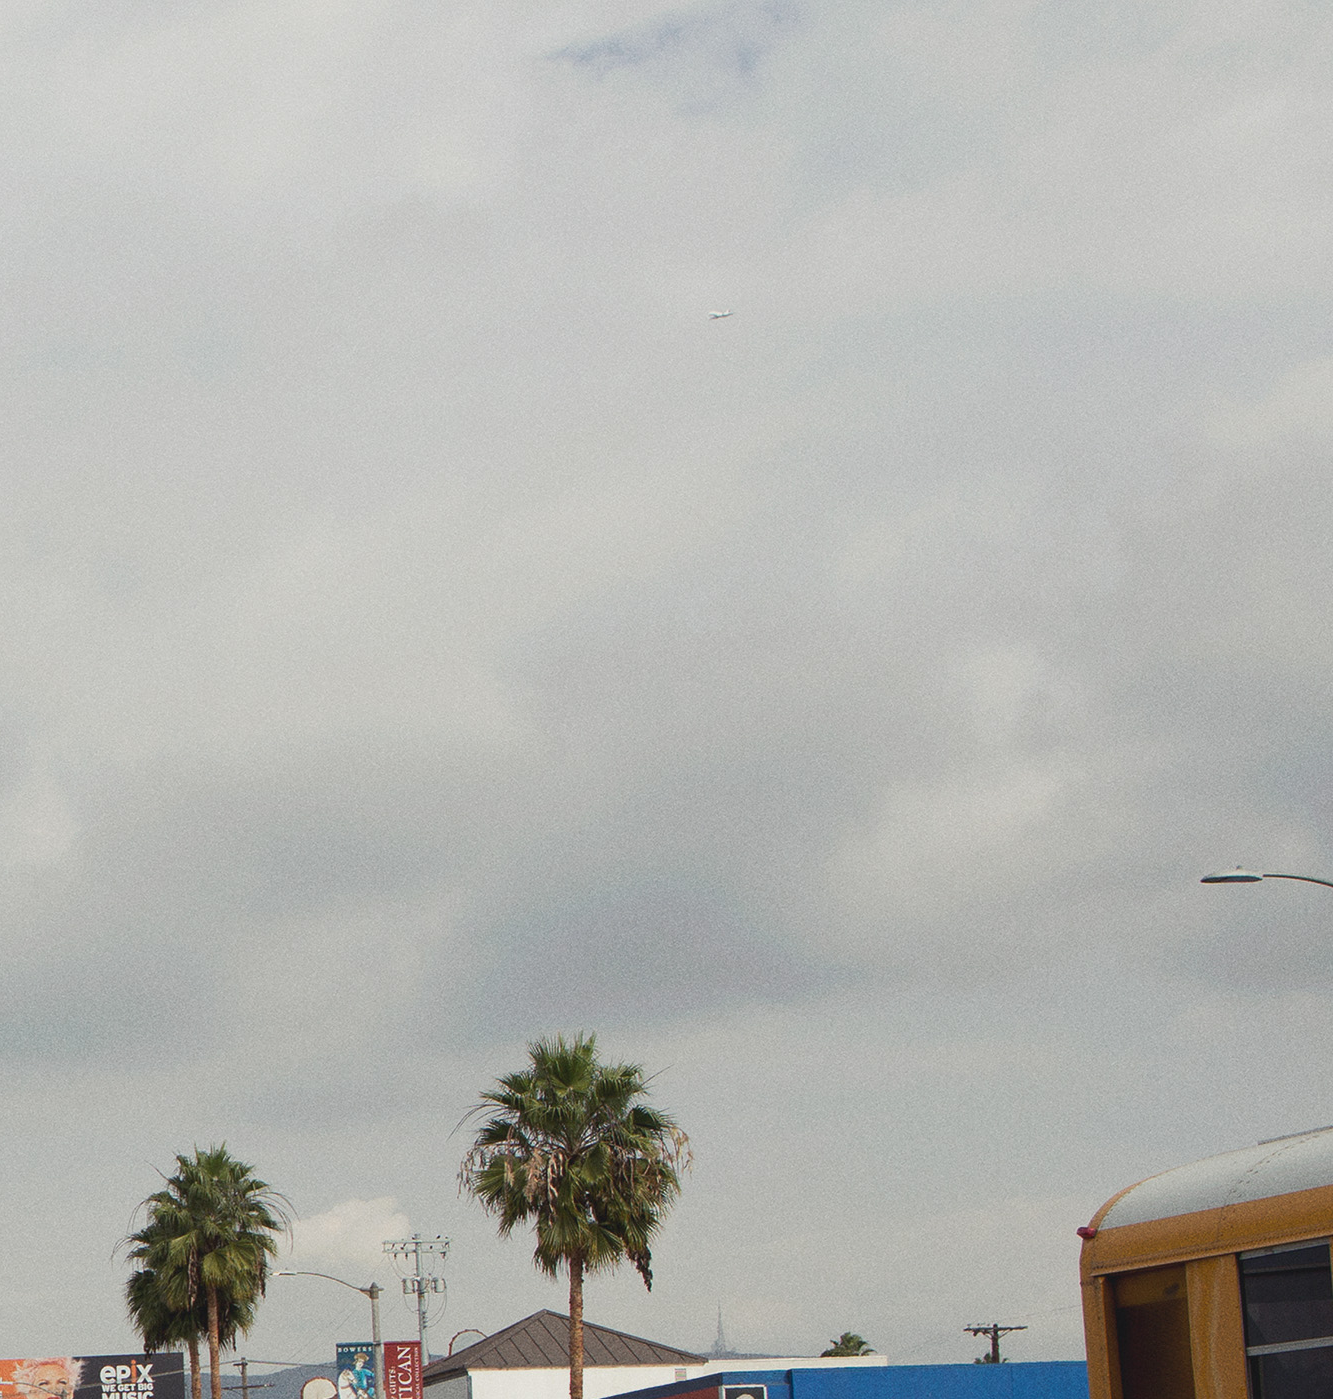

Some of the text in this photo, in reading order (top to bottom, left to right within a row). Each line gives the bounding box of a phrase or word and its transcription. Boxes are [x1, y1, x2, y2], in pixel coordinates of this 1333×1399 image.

[100, 1359, 154, 1384] epix
[102, 1383, 154, 1392] WE GET BIG
